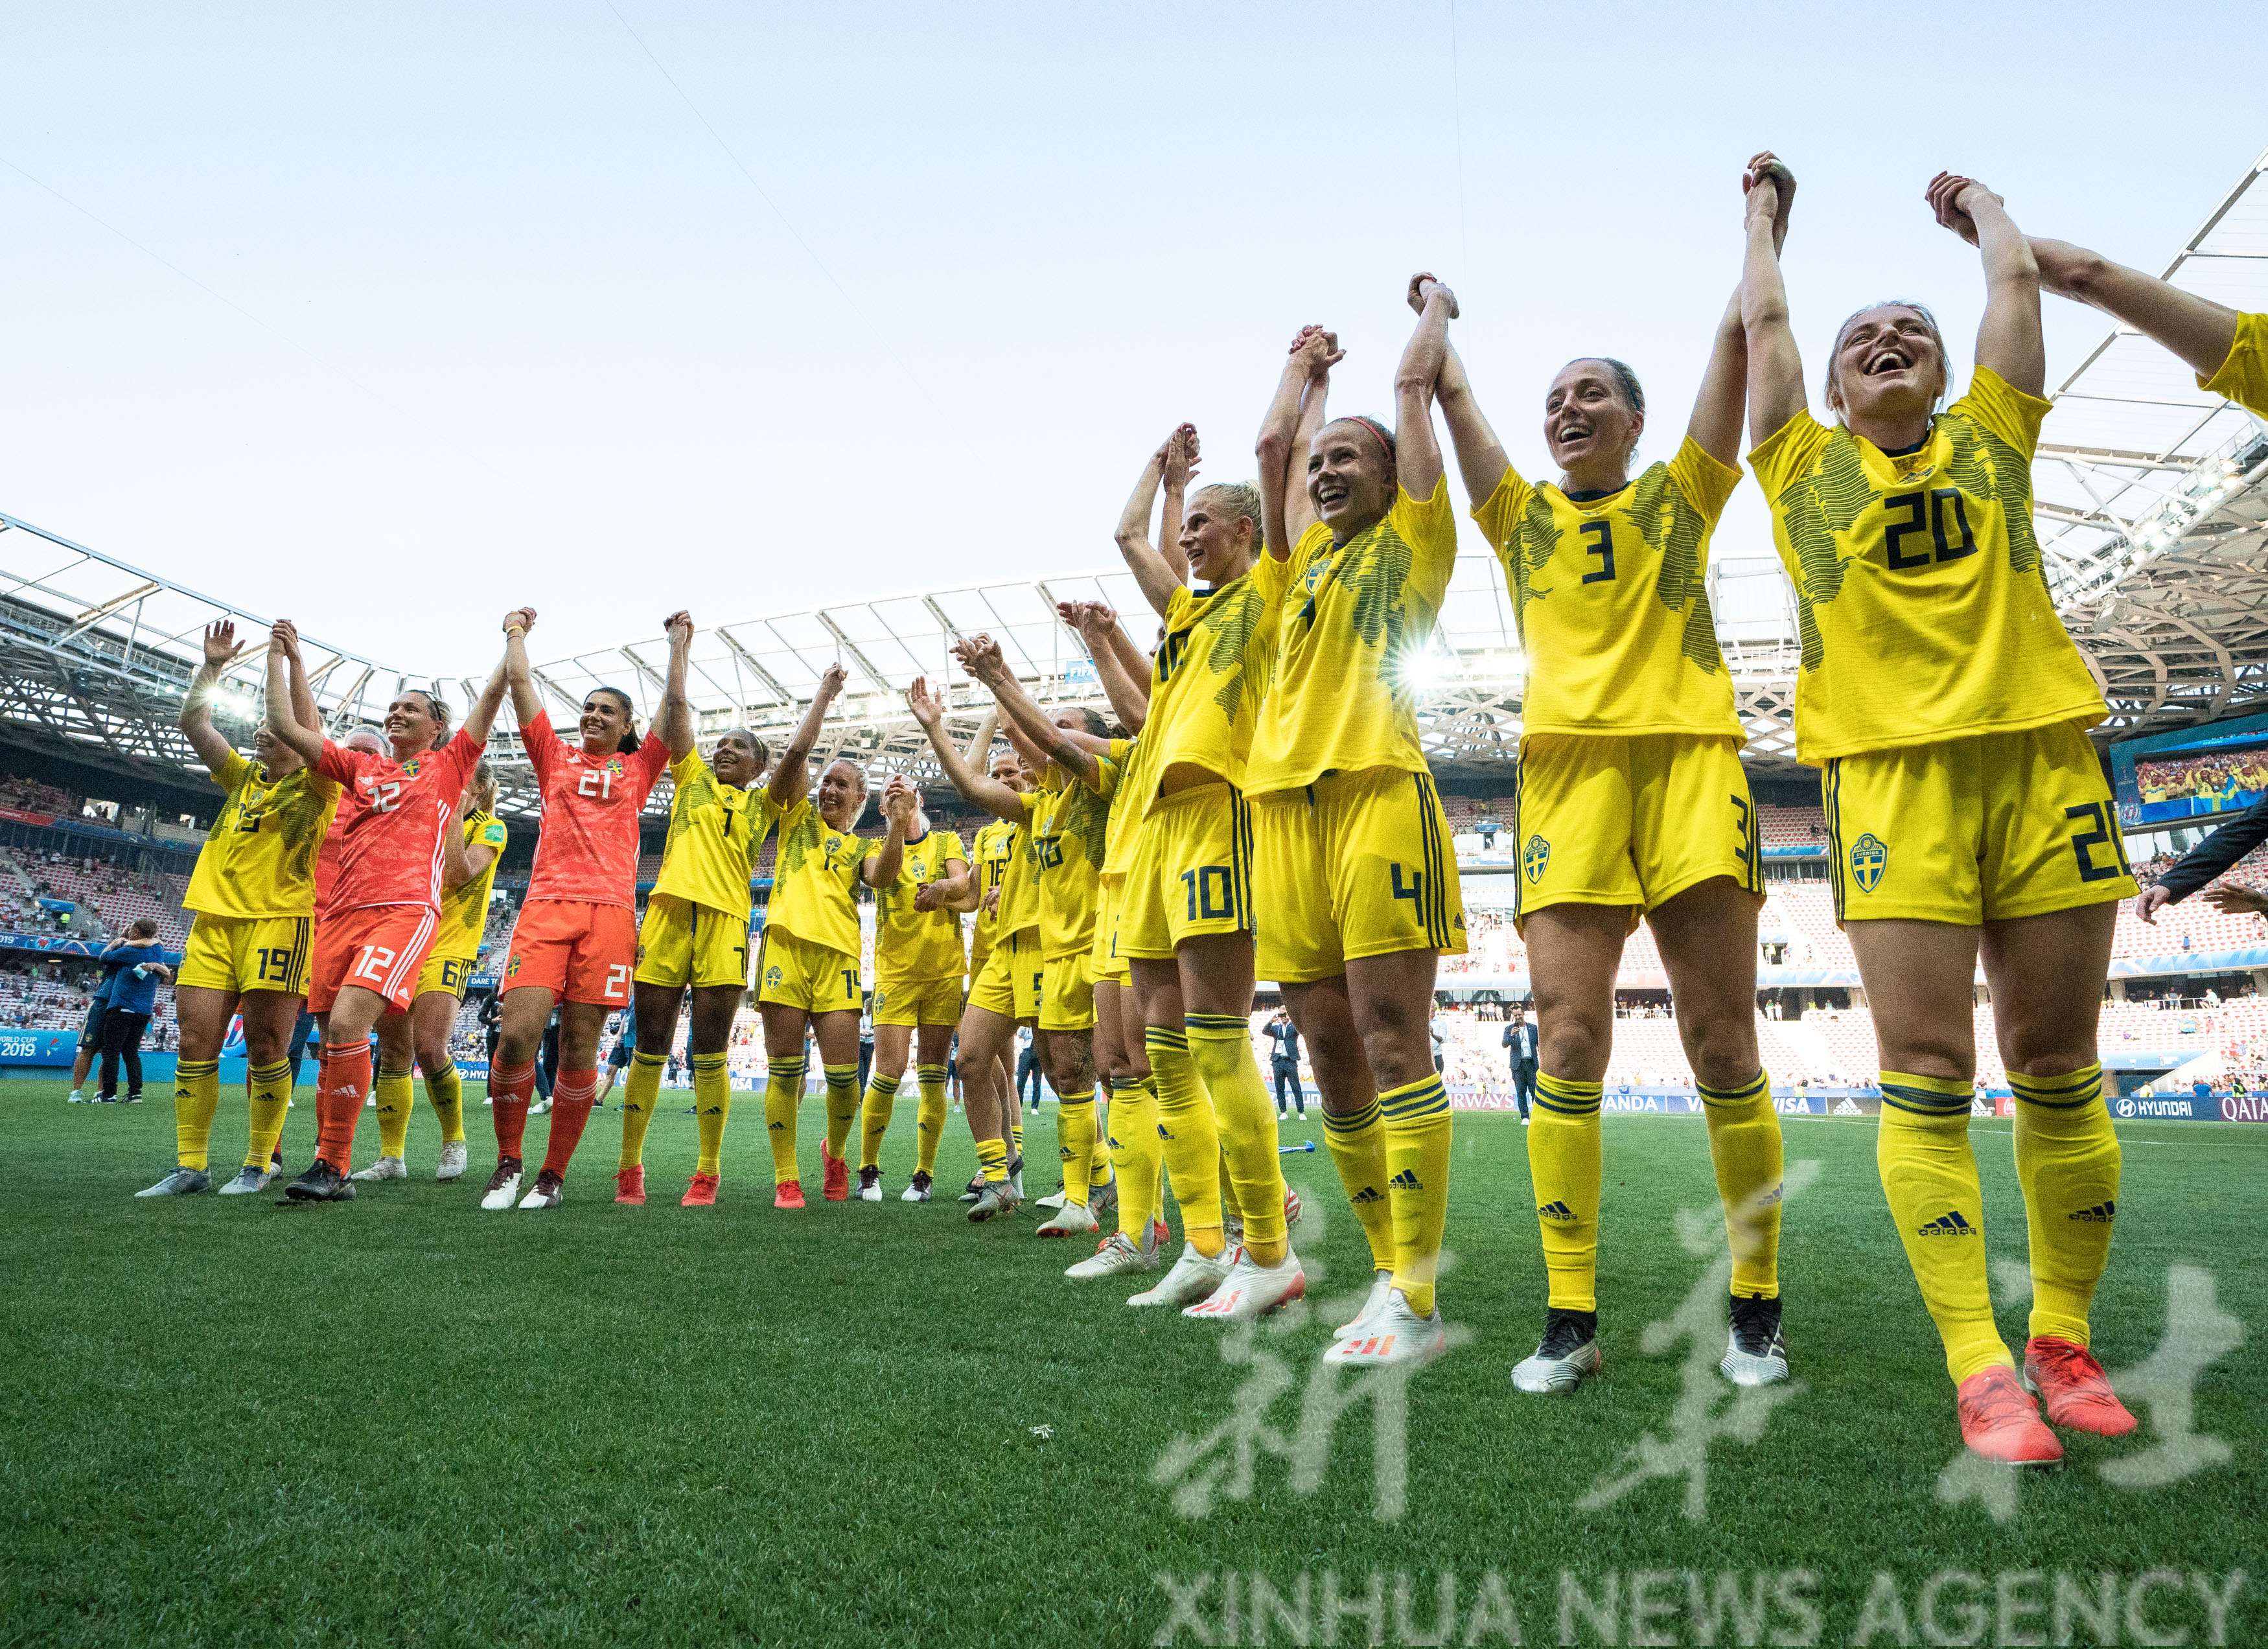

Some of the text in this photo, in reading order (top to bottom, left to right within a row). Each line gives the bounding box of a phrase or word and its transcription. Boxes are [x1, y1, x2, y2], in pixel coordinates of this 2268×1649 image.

[1884, 487, 1978, 571] 20
[1579, 520, 1615, 585] 3
[367, 781, 400, 813] 12
[577, 769, 611, 798] 21
[722, 807, 734, 838] 7
[1730, 794, 1752, 864] 3
[1034, 835, 1064, 871] 16
[1528, 848, 1545, 856] SVERIGE
[1181, 865, 1233, 921] 10
[1390, 862, 1424, 927] 4
[257, 949, 291, 982] 19
[353, 945, 396, 983] 12
[441, 960, 458, 988] 6
[733, 947, 745, 979] 7
[604, 963, 634, 998] 21
[1, 1043, 36, 1057] 2019
[1448, 1094, 1514, 1109] IRWAYS
[1601, 1096, 1658, 1111] ANDA
[2138, 1101, 2192, 1116] HYUNDAI
[1538, 1210, 1578, 1220] adidas
[1918, 1227, 1977, 1236] adidas
